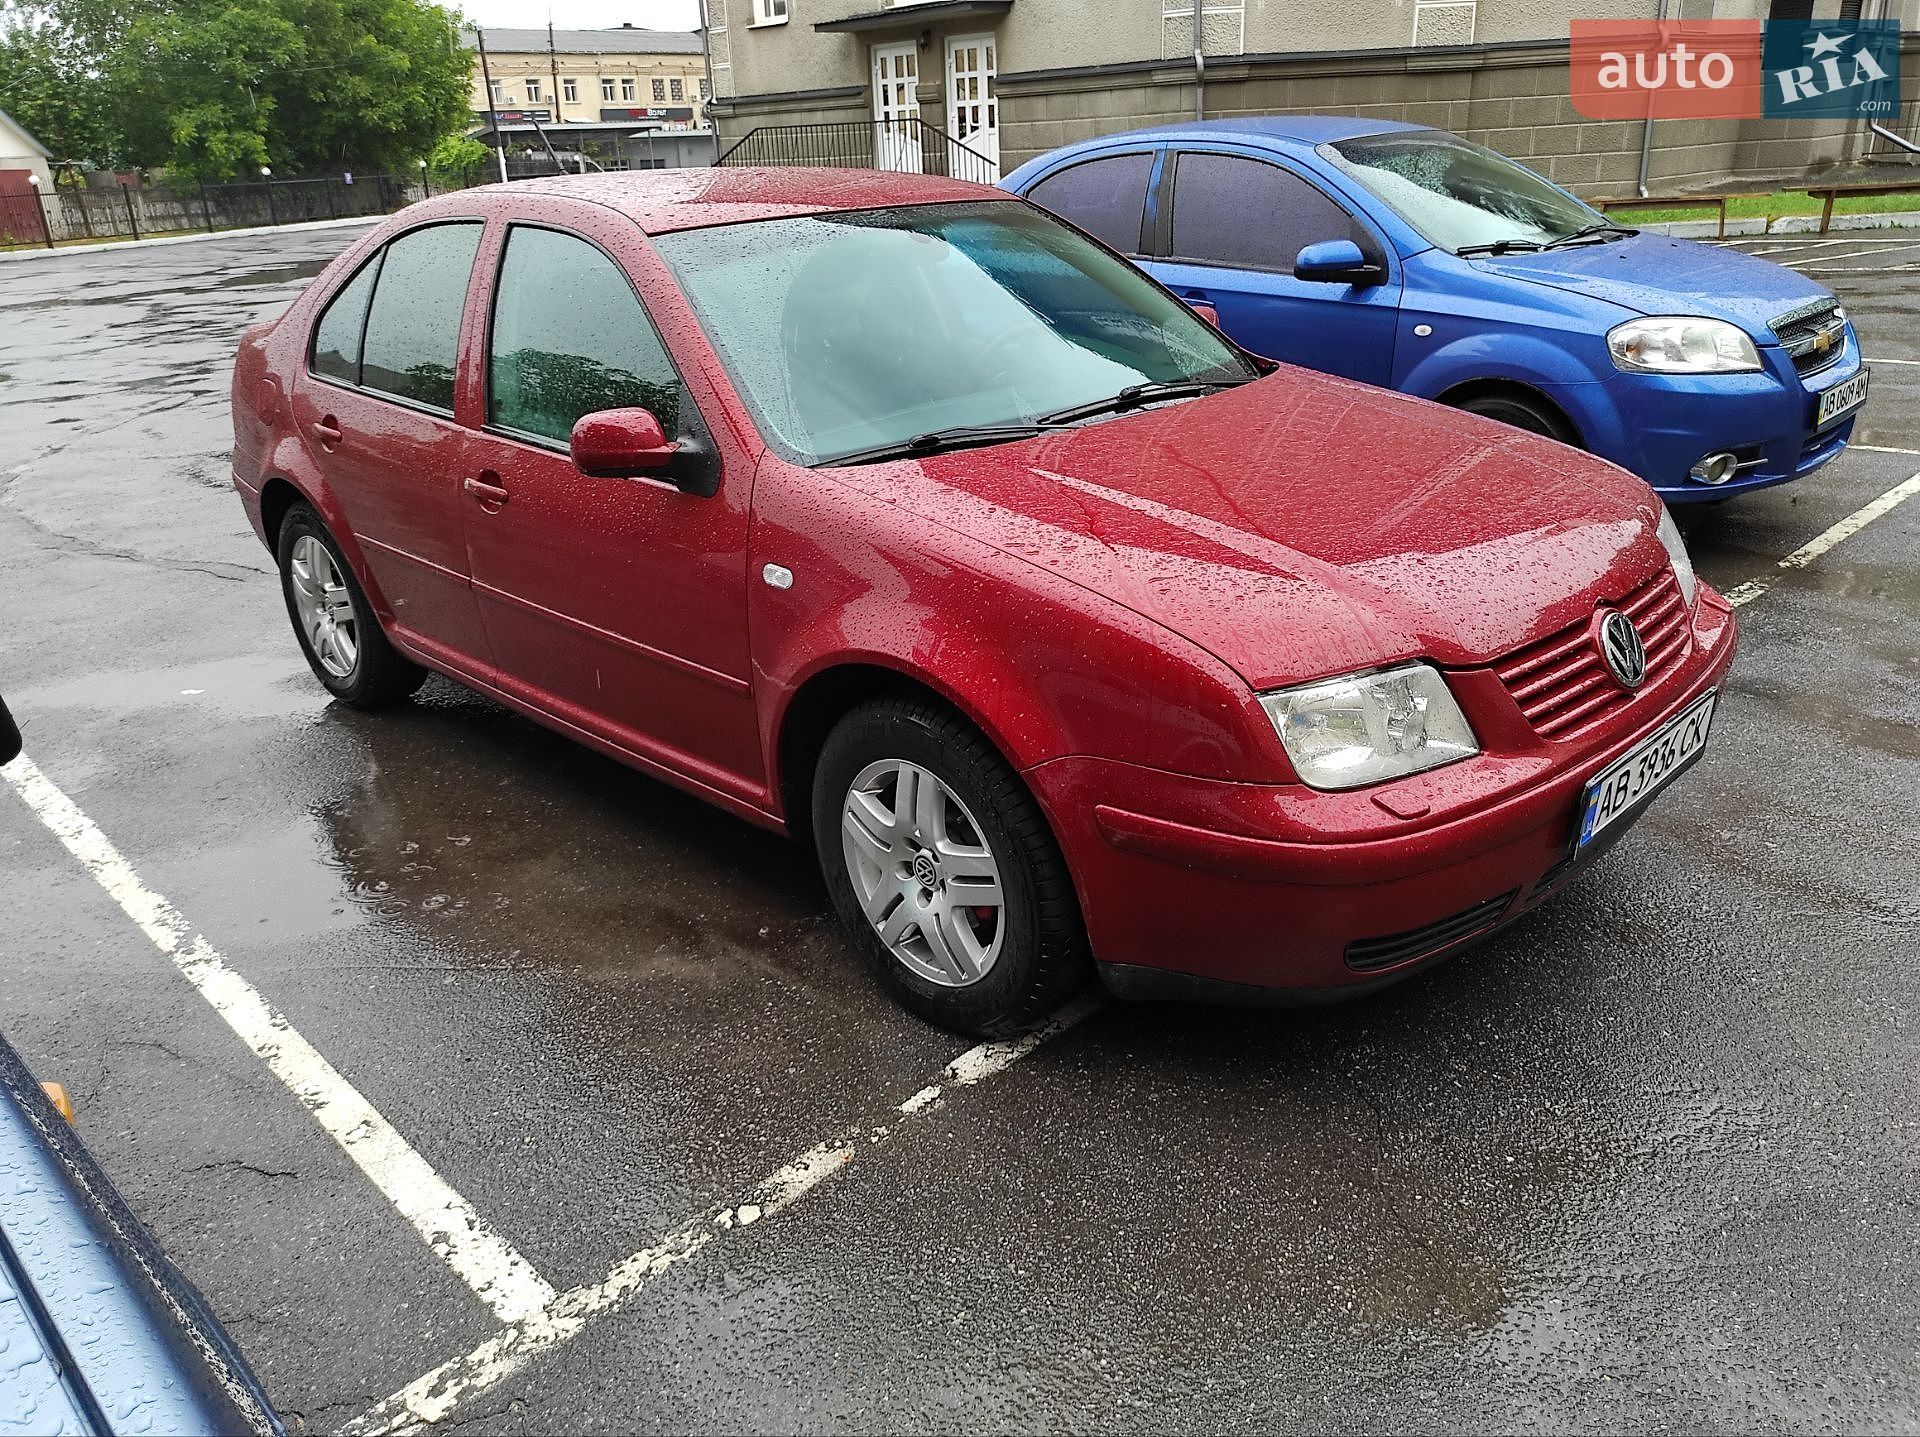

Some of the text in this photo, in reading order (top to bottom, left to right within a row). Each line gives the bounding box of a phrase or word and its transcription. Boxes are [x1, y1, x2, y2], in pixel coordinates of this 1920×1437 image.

[1823, 392, 1835, 418] AB
[1596, 704, 1710, 827] AB 3936 CK
